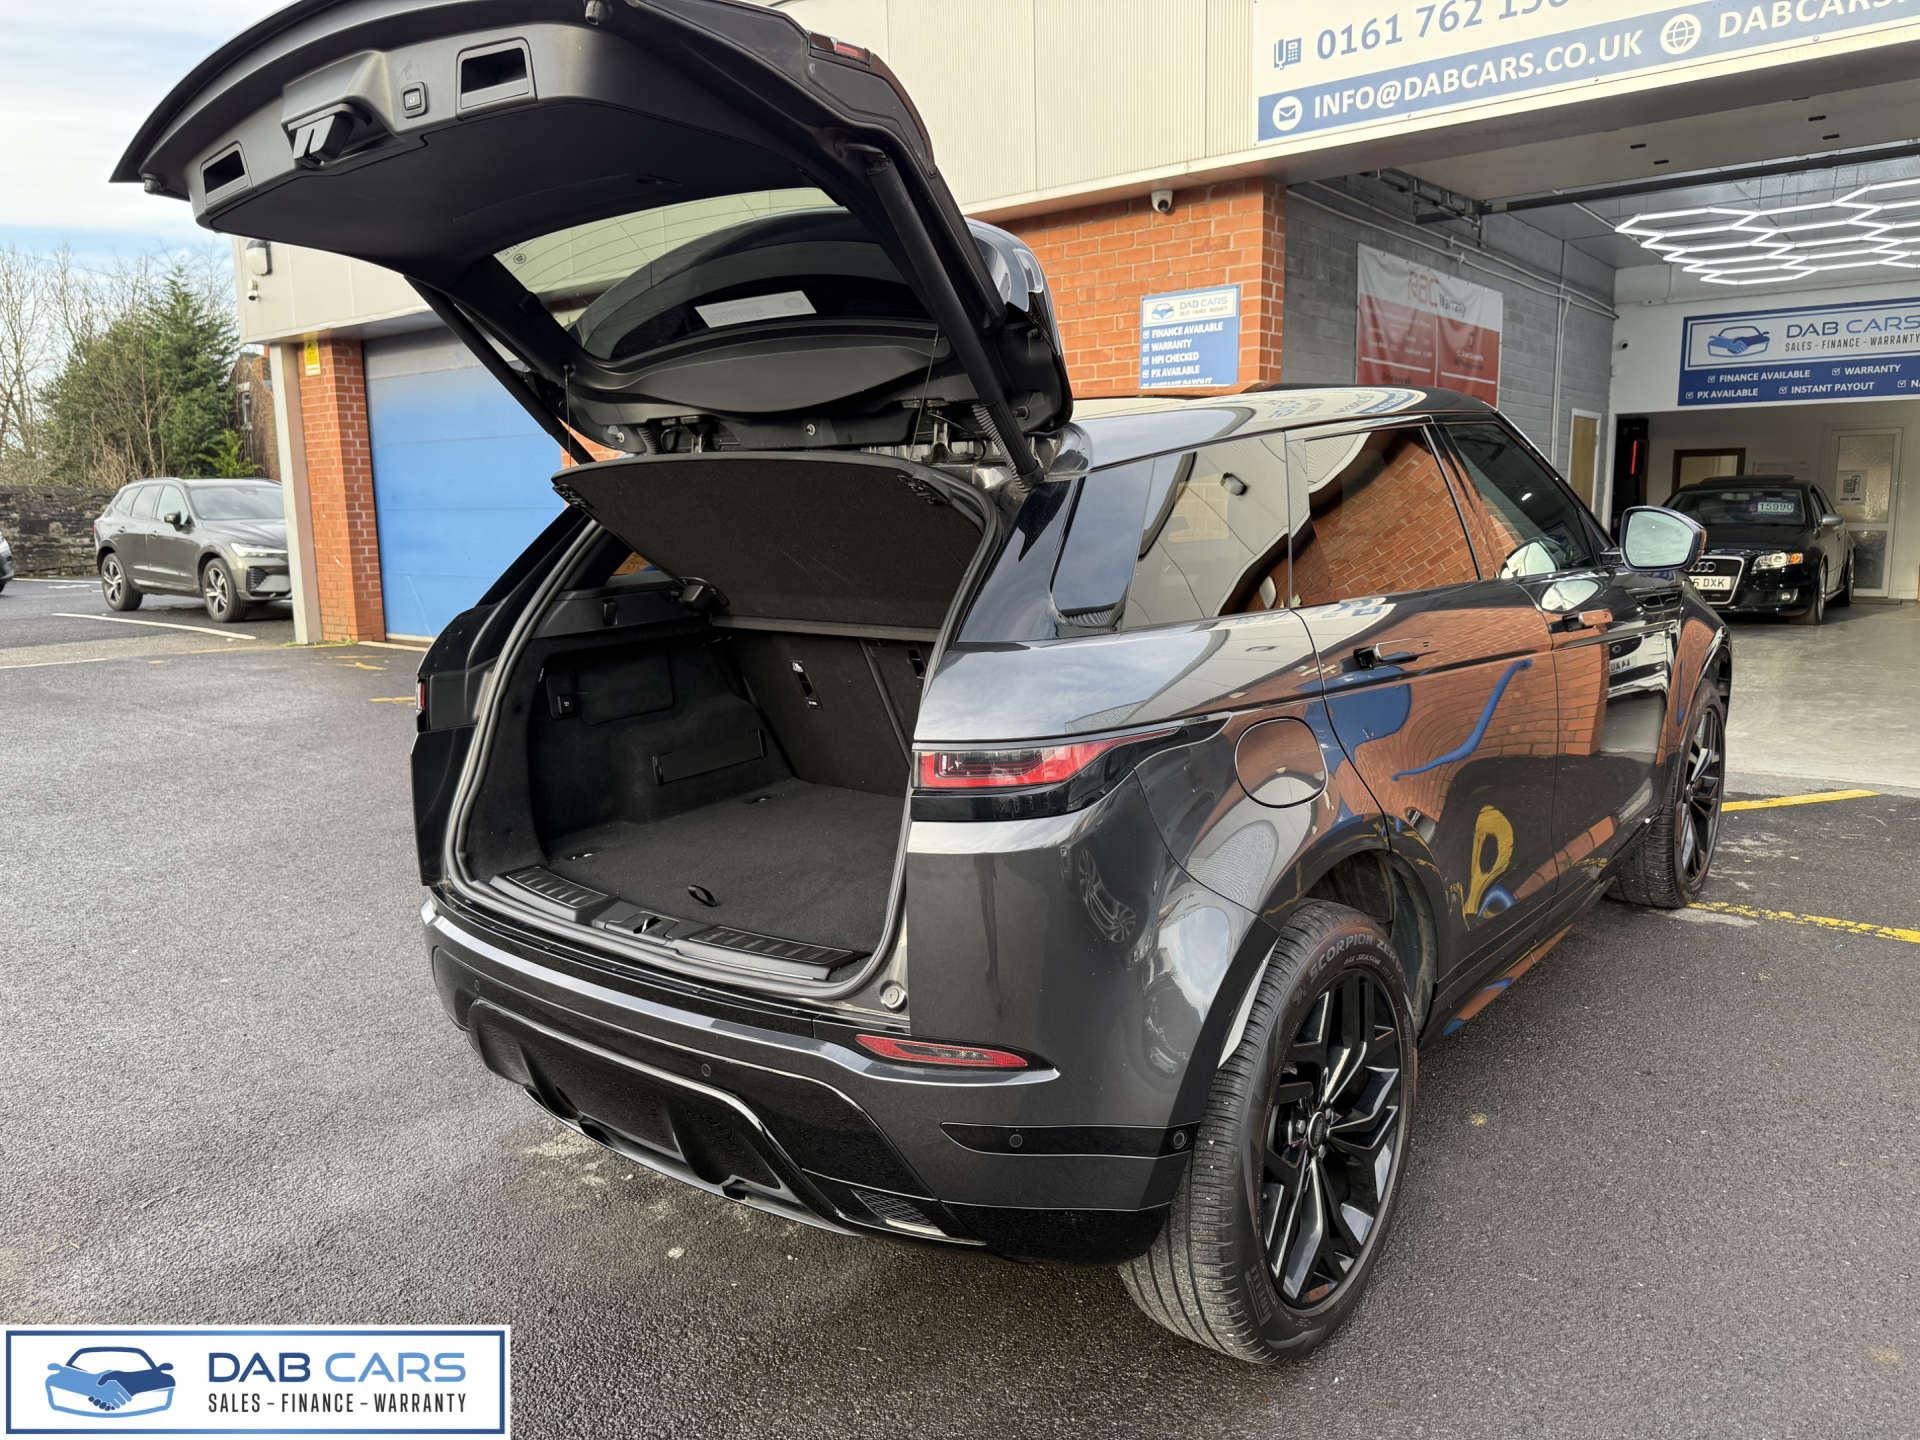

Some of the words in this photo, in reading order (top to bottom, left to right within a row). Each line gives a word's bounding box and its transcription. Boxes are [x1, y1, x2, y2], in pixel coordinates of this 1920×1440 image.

[1316, 13, 1403, 60] 0161
[1416, 0, 1483, 38] 762
[1313, 29, 1644, 120] INFO@DABCARS.CO.UK
[1151, 326, 1184, 338] FINANCE
[1184, 321, 1223, 334] AVAILABLE
[1785, 321, 1839, 339] DAB
[1846, 315, 1920, 334] CARS
[1151, 339, 1191, 351] WARRANTY
[1784, 341, 1813, 353] SALES
[1821, 335, 1861, 350] FINANCE
[1869, 332, 1920, 347] WARRANTY
[1165, 352, 1199, 363] CHECKED
[1162, 365, 1200, 376] AVAILABLE
[1719, 373, 1759, 383] FINANCE
[1761, 369, 1811, 380] AVAILABLE
[1844, 364, 1902, 376] WARRANTY
[1697, 391, 1709, 399] PX
[1710, 387, 1759, 399] AVAILABLE
[1791, 384, 1833, 394] INSTANT
[1834, 381, 1875, 392] PAYOUT
[1703, 578, 1726, 588] DXK
[1310, 933, 1374, 984] SCORPION
